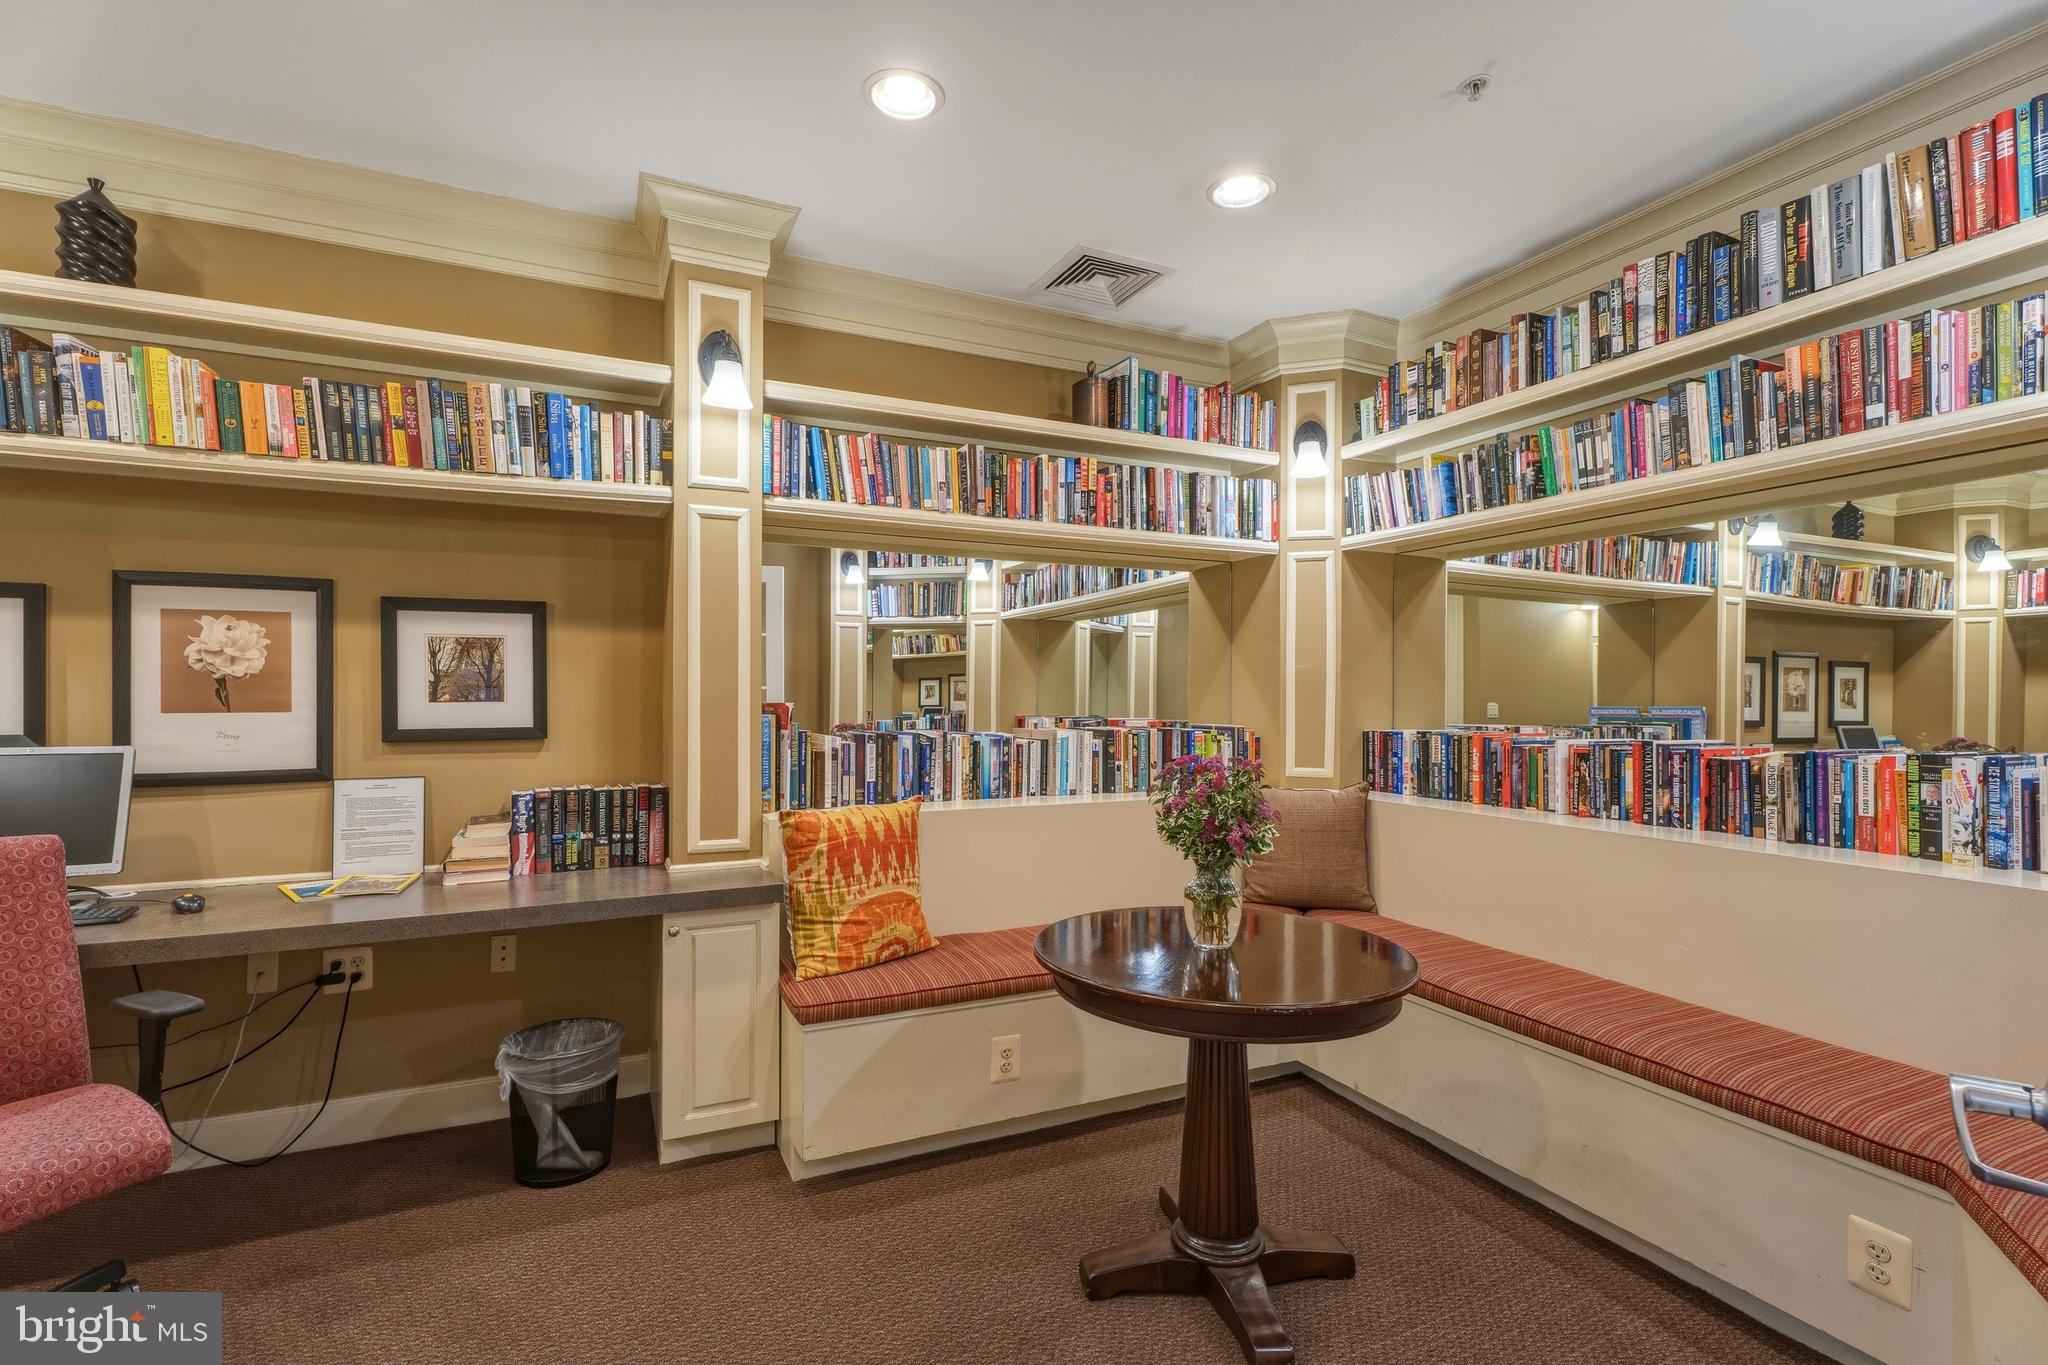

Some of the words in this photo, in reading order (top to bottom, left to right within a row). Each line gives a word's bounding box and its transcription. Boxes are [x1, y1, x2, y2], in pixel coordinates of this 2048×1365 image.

[1971, 127, 1991, 152] Tom
[1996, 128, 2015, 160] WAR
[1968, 151, 1992, 187] Clancy
[1975, 187, 1987, 202] Red
[1975, 202, 1988, 229] Rabbit
[1760, 220, 1777, 275] DOMINION
[1849, 338, 1861, 362] BEST
[1850, 361, 1862, 398] RECIPES
[550, 402, 562, 424] Silva
[1644, 745, 1653, 785] NORMAN
[1907, 759, 1920, 781] DAVID
[1988, 766, 2001, 777] ICE
[1644, 787, 1653, 813] LEAR
[1988, 777, 2001, 803] STATION
[553, 792, 561, 813] VINCE
[1753, 793, 1762, 816] BIBLE
[1767, 808, 1776, 832] POLICE
[1908, 810, 1920, 830] BLACK
[1988, 803, 2001, 833] NAUTILUS
[1908, 831, 1920, 854] STORM
